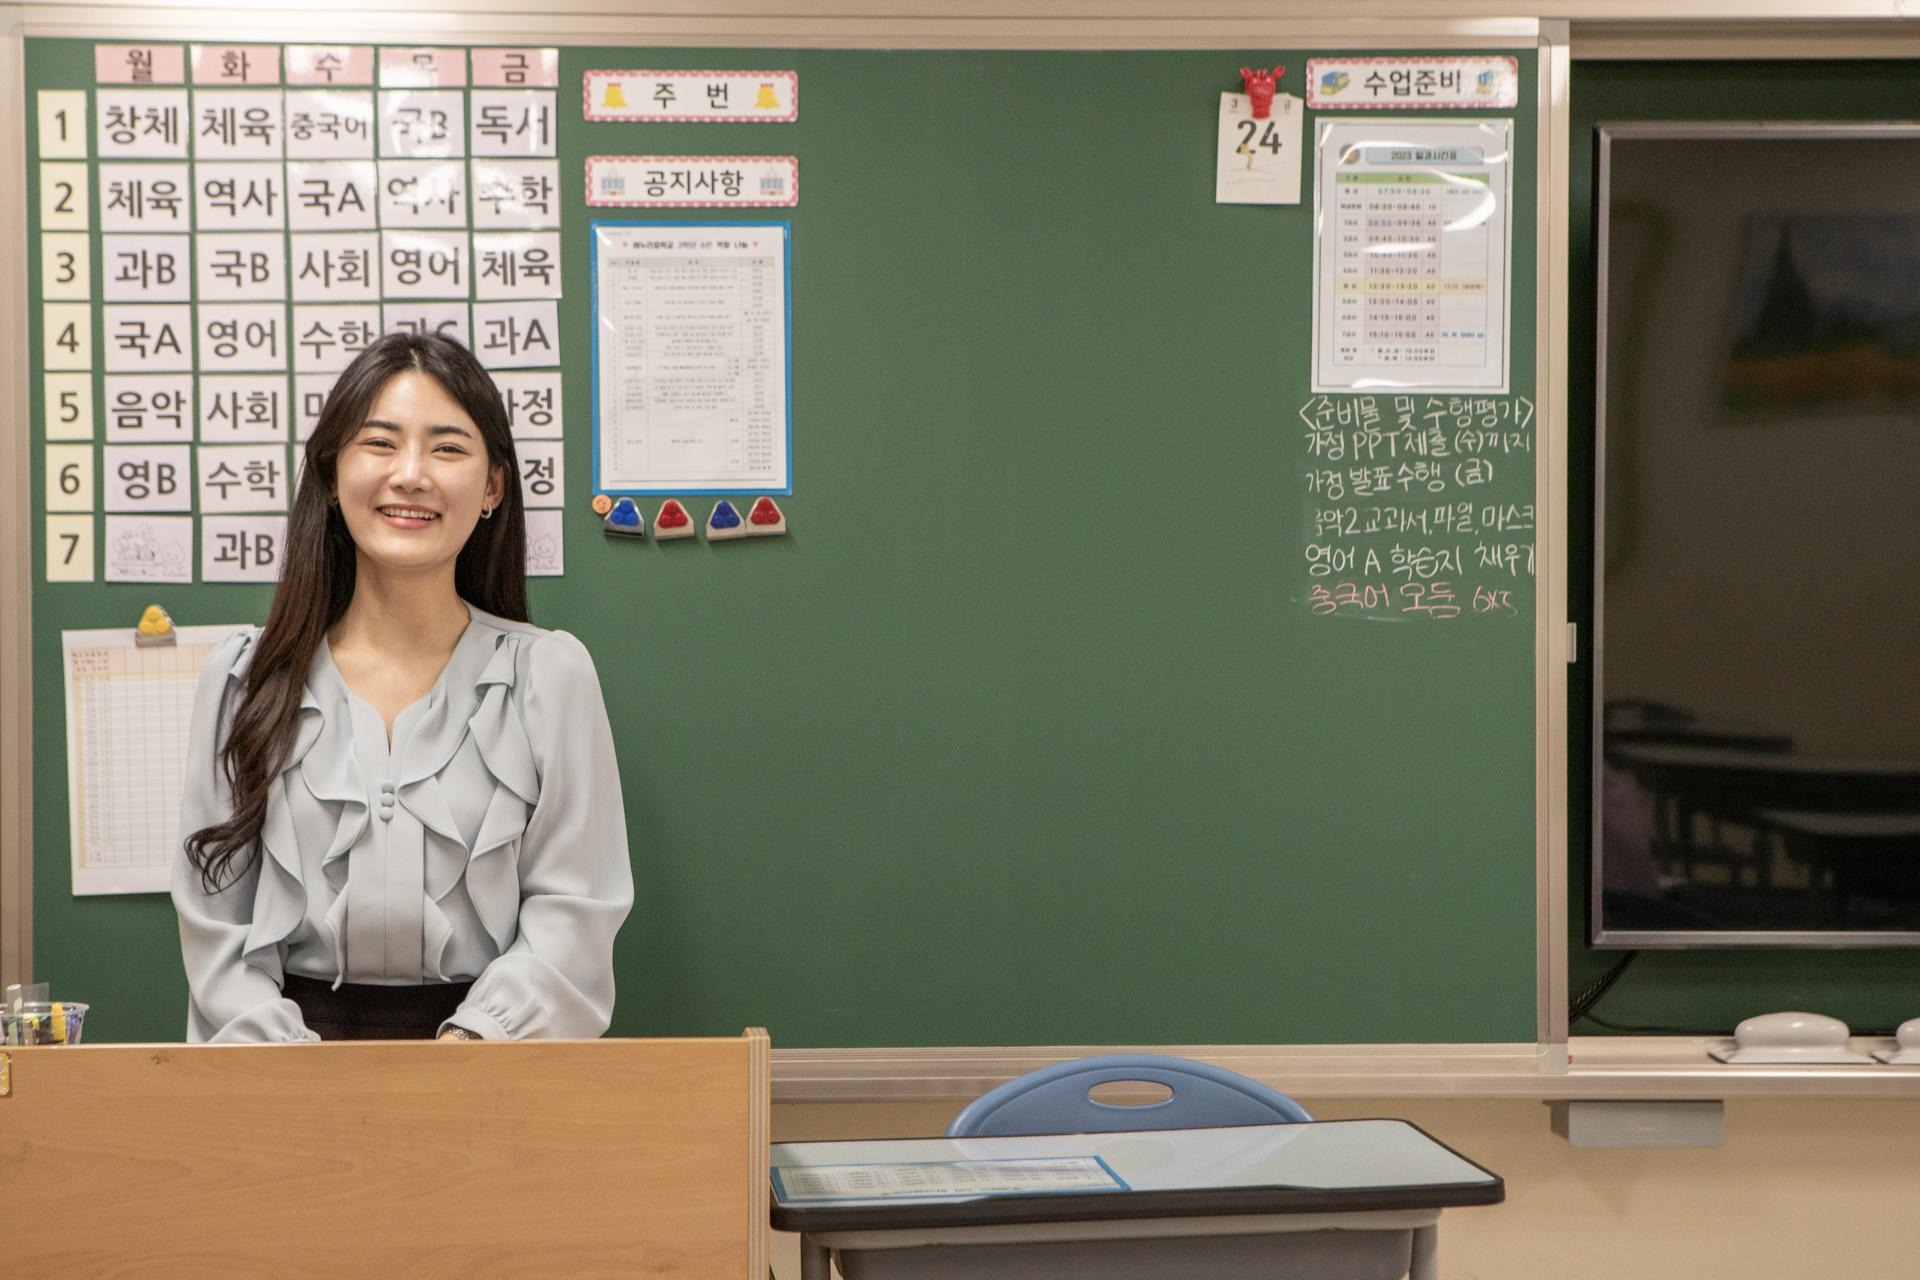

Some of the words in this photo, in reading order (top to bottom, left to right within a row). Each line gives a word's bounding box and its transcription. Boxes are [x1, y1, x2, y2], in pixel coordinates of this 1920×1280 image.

[125, 50, 155, 83] 월
[221, 51, 250, 81] 화
[314, 55, 341, 83] 수
[501, 53, 529, 83] 금
[1364, 69, 1461, 96] 수업준비
[653, 83, 676, 109] 주
[707, 83, 728, 109] 번
[56, 110, 66, 141] 1
[106, 106, 178, 144] 창체
[202, 108, 275, 146] 체육
[291, 114, 366, 139] 중국어
[476, 106, 548, 145] 독서
[1236, 120, 1282, 154] 24
[55, 182, 73, 213] 2
[108, 180, 182, 219] 체육
[204, 179, 277, 216] 역사
[299, 180, 365, 217] 국A
[644, 170, 743, 197] 공지사항
[56, 252, 75, 283] 3
[115, 250, 176, 289] 과B
[211, 250, 269, 287] 국B
[300, 250, 369, 288] 사회
[391, 247, 459, 285] 영어
[482, 248, 554, 286] 체육
[57, 322, 79, 353] 4
[115, 321, 182, 359] 국A
[207, 320, 276, 358] 영어
[300, 321, 374, 358] 수학
[484, 317, 551, 355] 과A
[61, 392, 79, 423] 5
[112, 391, 186, 429] 음악
[207, 392, 278, 429] 사회
[508, 387, 553, 426] 정
[1395, 397, 1418, 431] 및
[60, 464, 80, 495] 6
[118, 460, 176, 500] 영B
[206, 461, 280, 500] 수학
[1306, 469, 1344, 500] 가정
[60, 534, 79, 565] 7
[214, 531, 274, 570] 과B
[1305, 543, 1355, 576] 영어
[1365, 549, 1381, 575] A
[1309, 583, 1390, 615] 중국어
